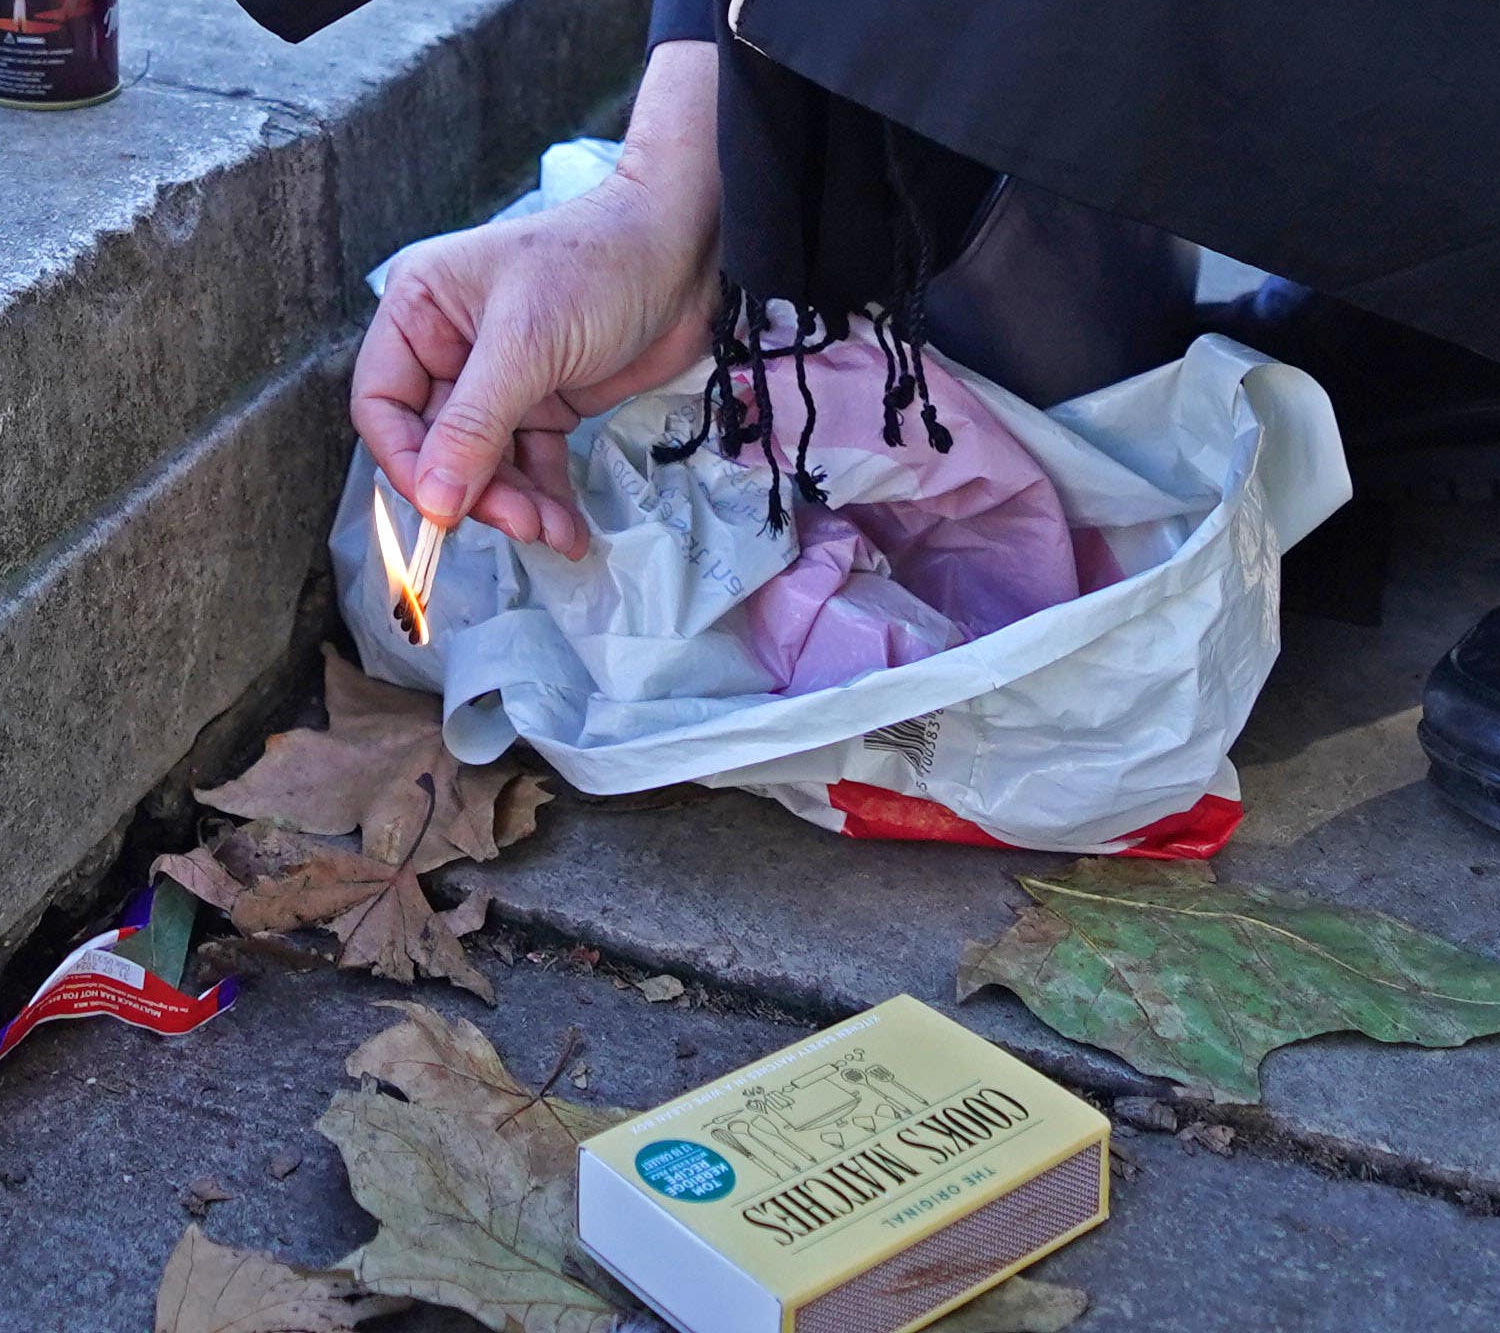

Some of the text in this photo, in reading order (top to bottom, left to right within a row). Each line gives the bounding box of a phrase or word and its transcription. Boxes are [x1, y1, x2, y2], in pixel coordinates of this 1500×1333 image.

[81, 990, 98, 999] NOT
[100, 990, 117, 1002] BAR
[117, 997, 161, 1018] MULTIPACK
[667, 1160, 710, 1185] RECIPE
[742, 1088, 1029, 1246] COOK'S MATCHES
[665, 1163, 729, 1196] KERRIDGE
[692, 1180, 722, 1196] TOM
[881, 1166, 997, 1229] THE ORIGINAL
